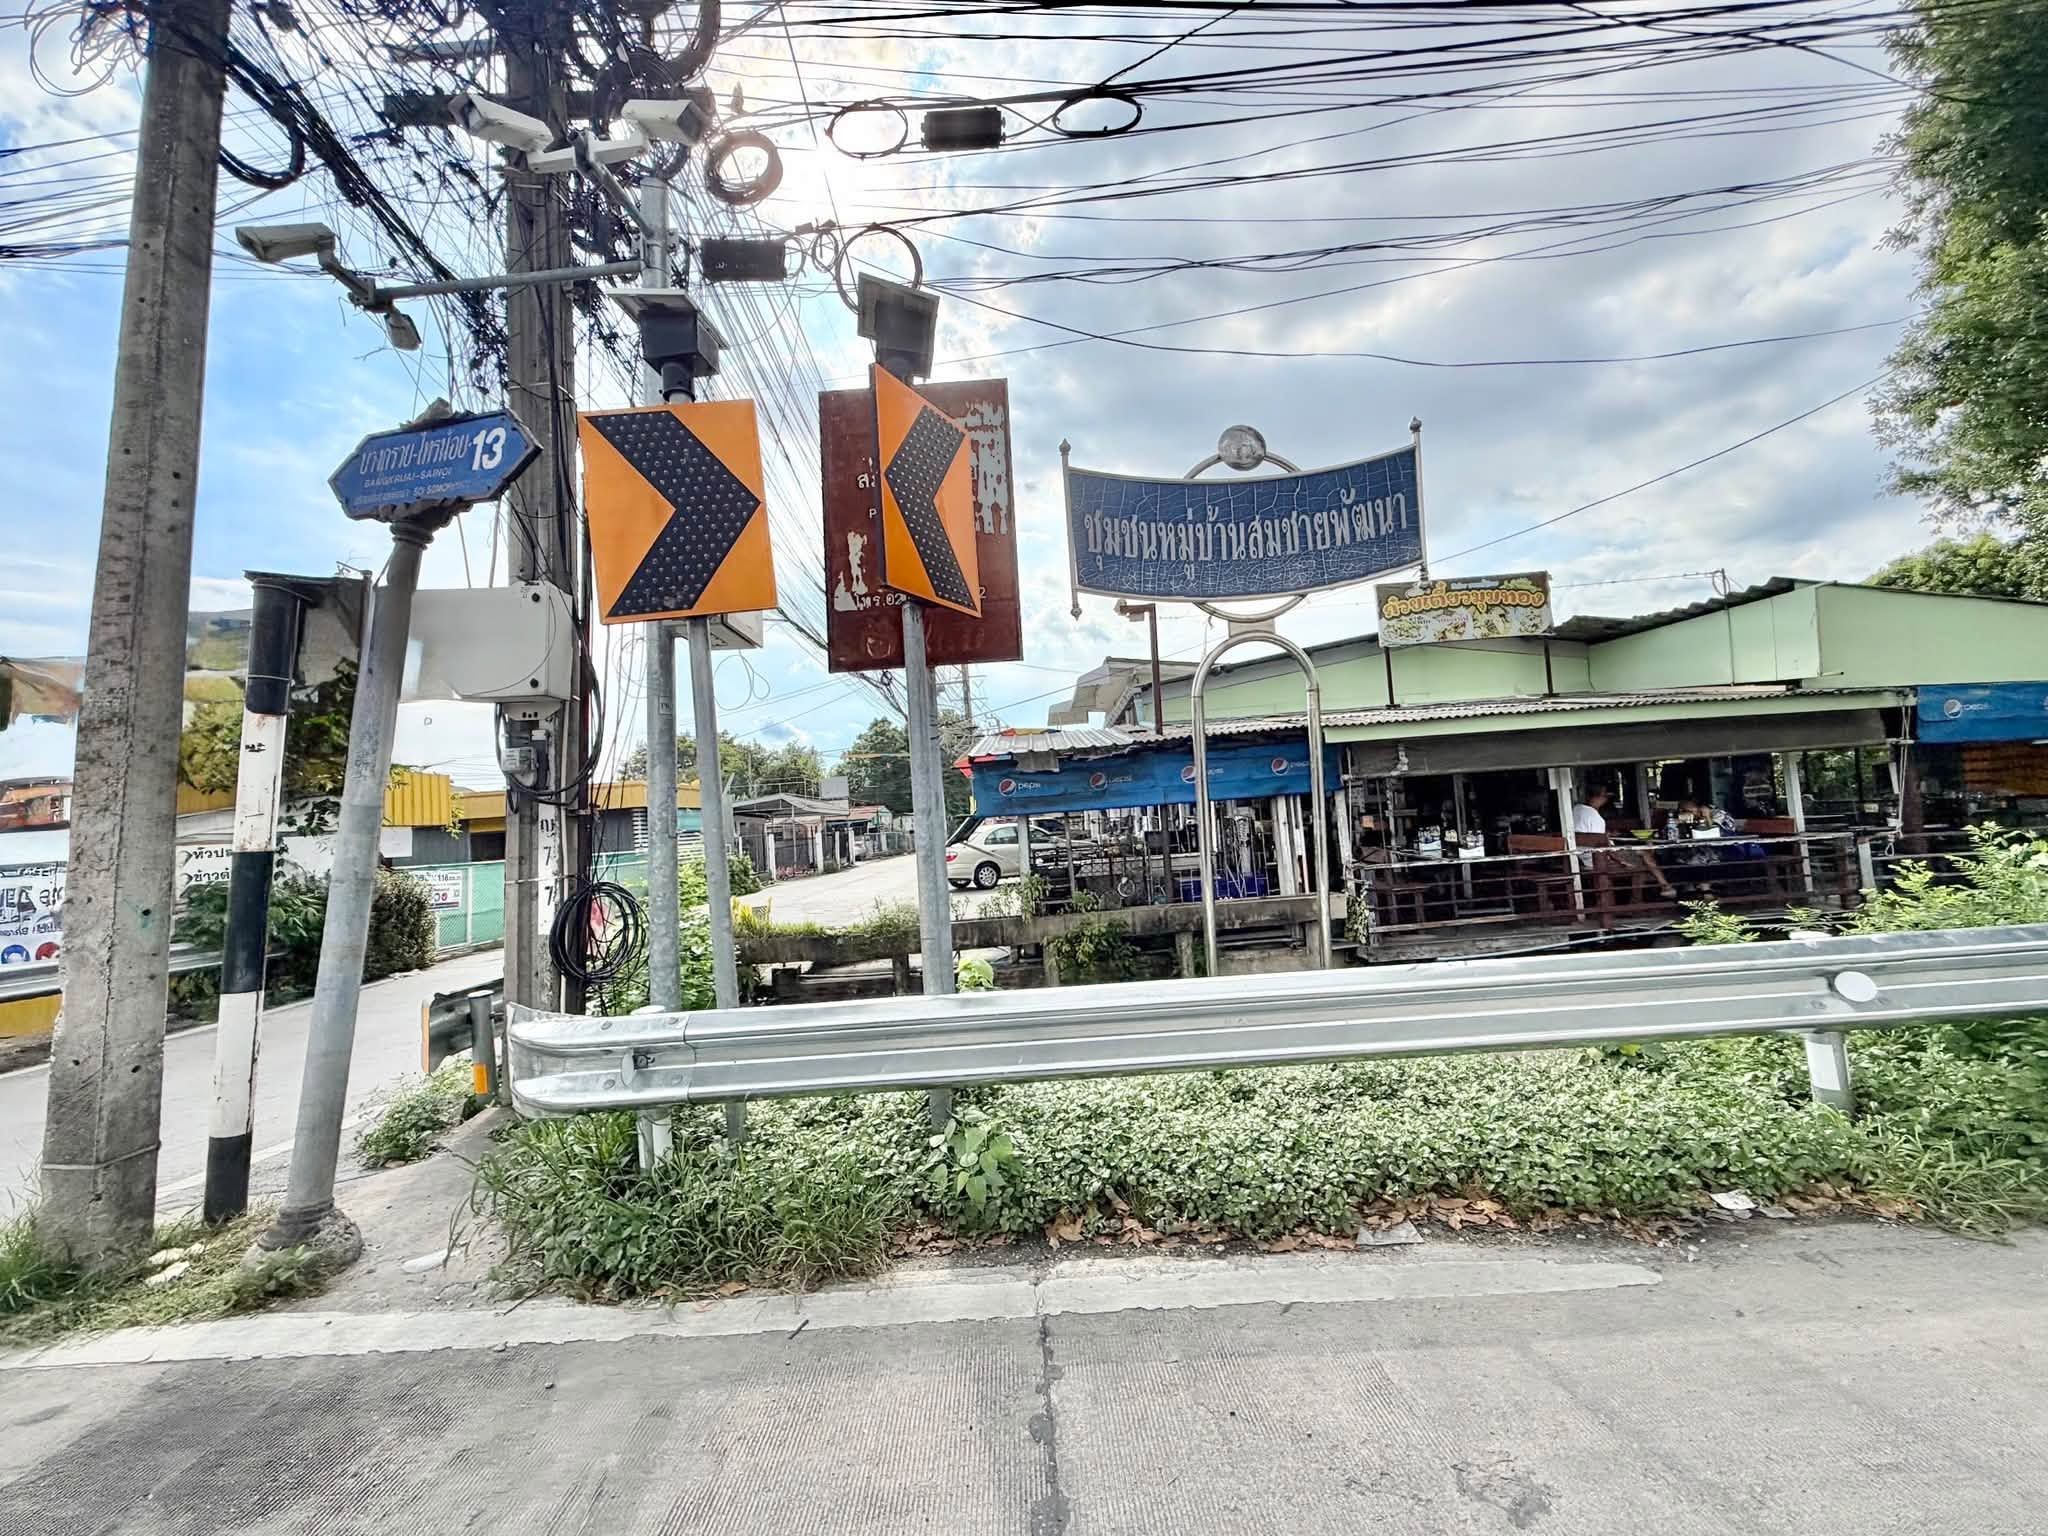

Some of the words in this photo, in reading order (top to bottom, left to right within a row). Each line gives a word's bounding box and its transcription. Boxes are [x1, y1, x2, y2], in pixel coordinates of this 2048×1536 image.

[472, 426, 507, 471] 13
[1083, 486, 1407, 580] ชุมชนหมู่บ้านสมชายพัฒนา
[1018, 782, 1041, 792] pepsi
